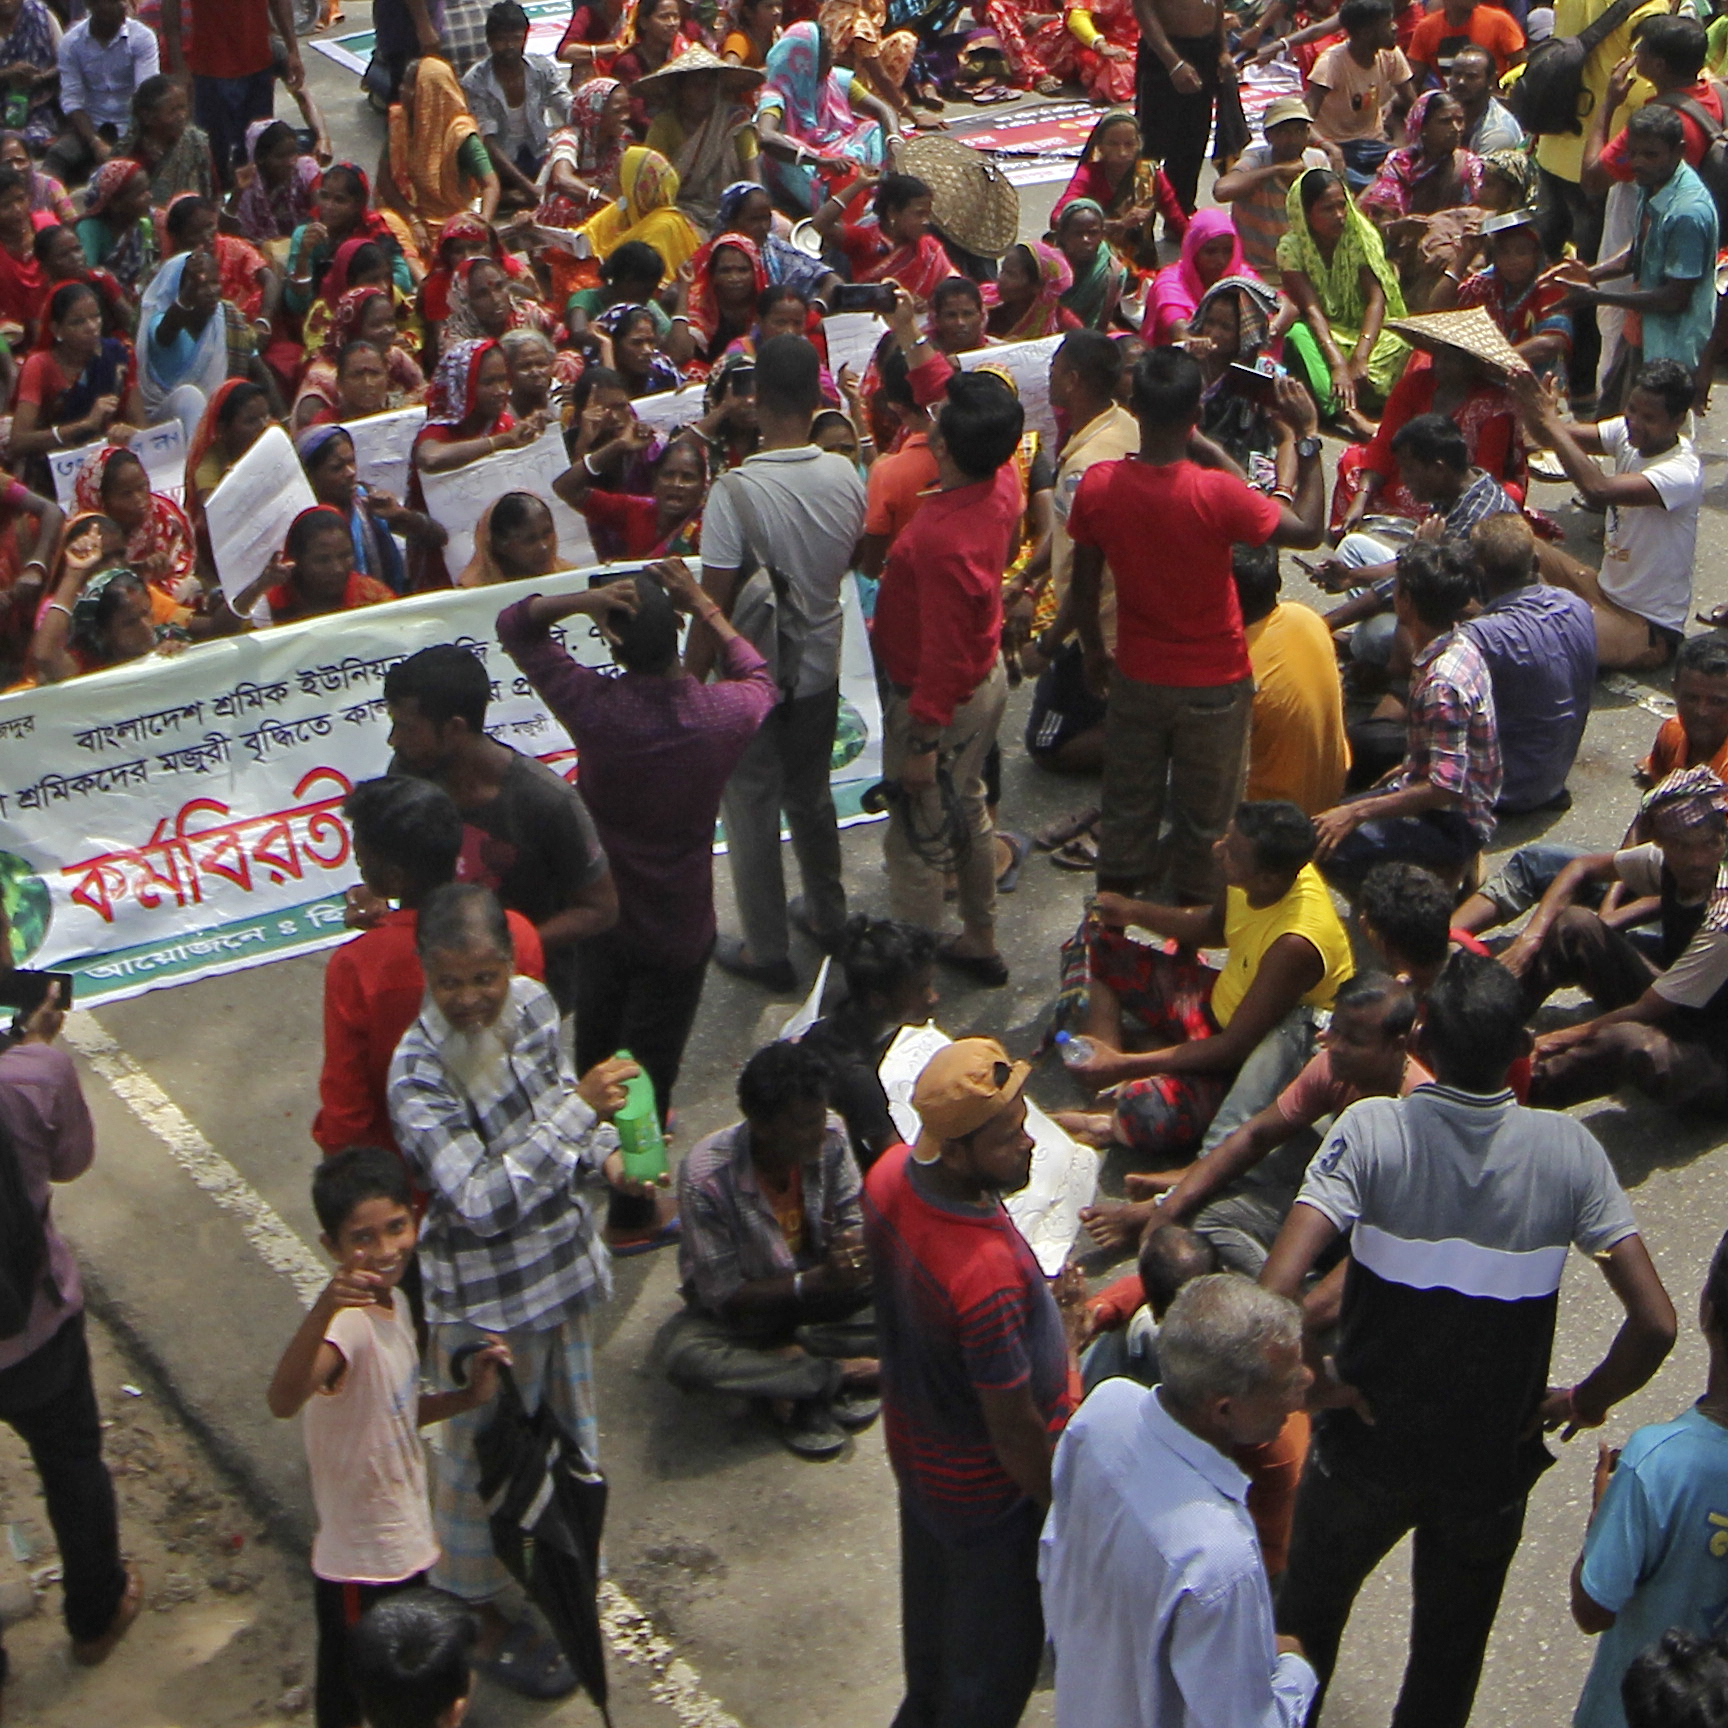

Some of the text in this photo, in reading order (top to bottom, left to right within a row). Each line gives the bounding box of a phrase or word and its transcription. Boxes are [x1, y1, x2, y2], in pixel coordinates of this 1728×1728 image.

[73, 701, 204, 751] বাংলাদেশ
[214, 679, 289, 718] শ্রমিক
[17, 759, 149, 809] শ্রমিকদের
[158, 731, 233, 774] মজুরী
[239, 711, 332, 764] বৃদ্ধিতে
[84, 924, 268, 981] আয়োজনে
